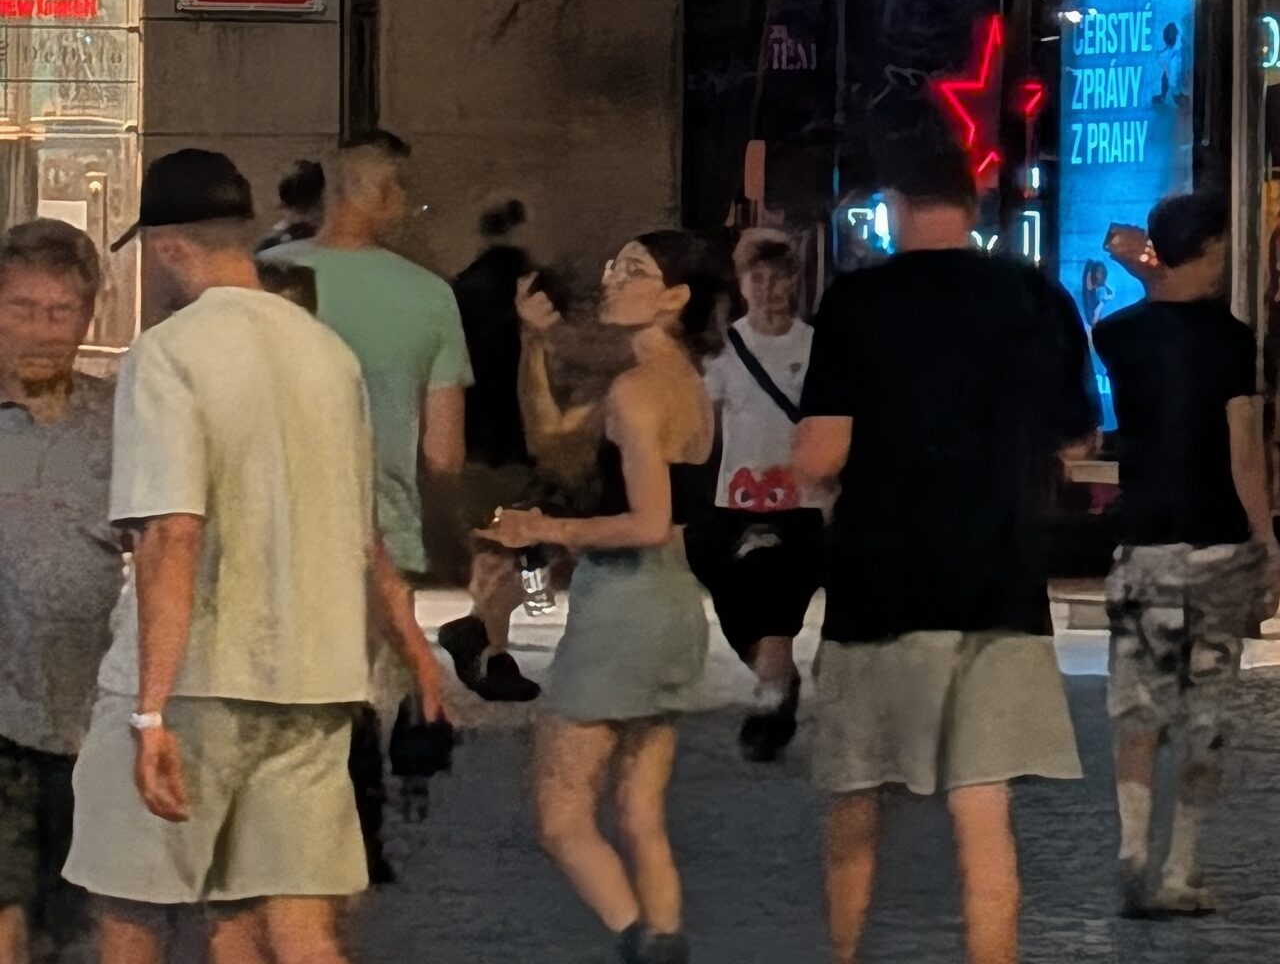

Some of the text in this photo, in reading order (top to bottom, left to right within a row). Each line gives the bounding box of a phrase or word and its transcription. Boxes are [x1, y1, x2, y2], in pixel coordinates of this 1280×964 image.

[1071, 58, 1143, 110] ZPRÁVY
[1071, 120, 1149, 165] Z PRAHY
